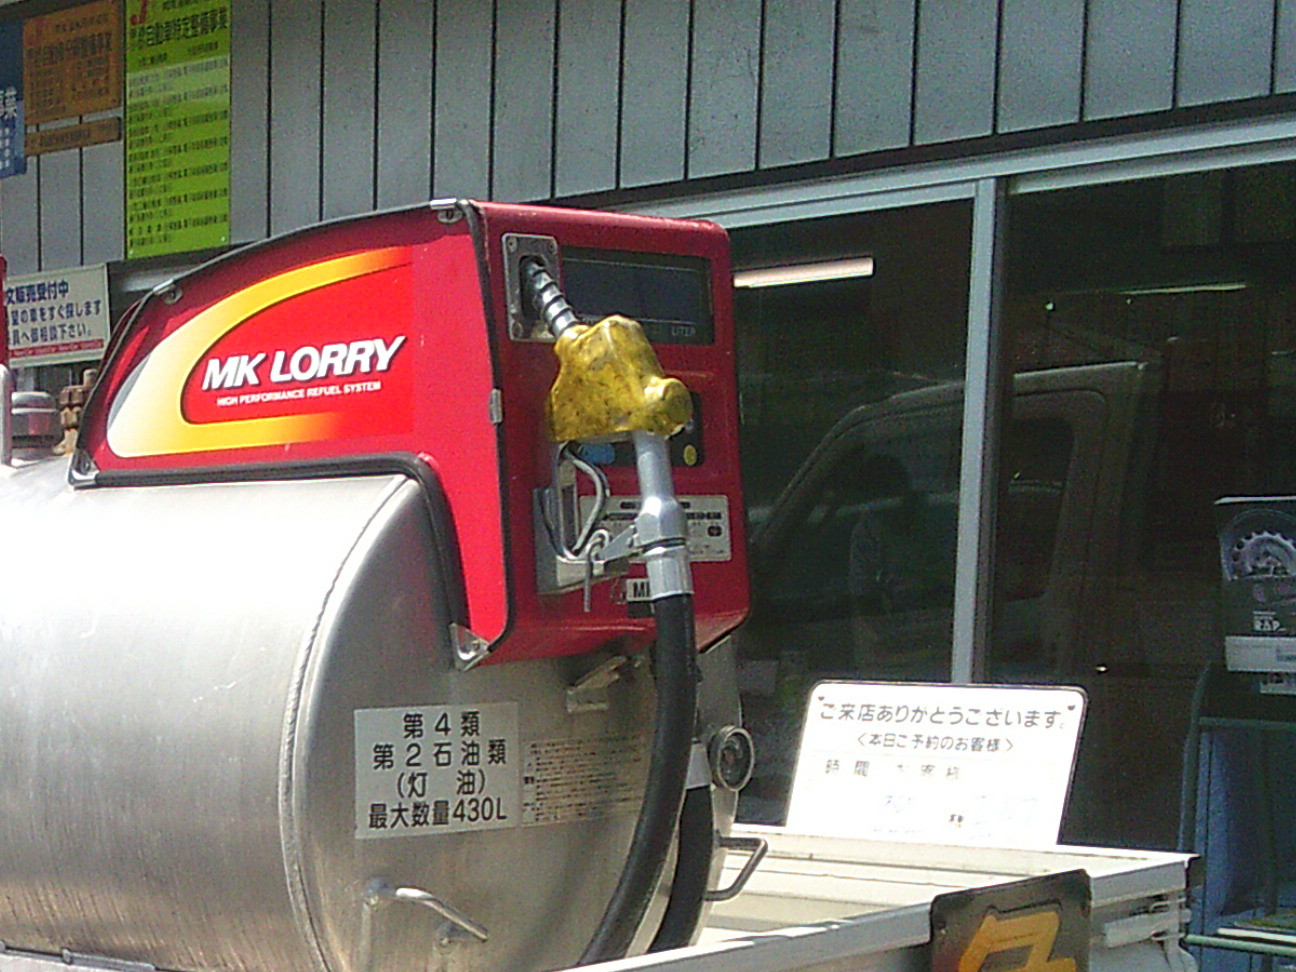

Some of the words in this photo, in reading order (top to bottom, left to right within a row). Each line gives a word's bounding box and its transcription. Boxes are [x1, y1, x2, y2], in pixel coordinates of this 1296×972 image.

[202, 352, 267, 391] MK
[269, 335, 407, 384] LORRY
[216, 396, 239, 407] HIGH
[239, 388, 305, 405] PERFORMANCE
[306, 383, 342, 397] REFUEL
[343, 380, 382, 394] SYSTEM
[403, 711, 481, 739] 第4類
[373, 738, 507, 770] 第2石油類
[368, 797, 508, 829] 最大数量430L
